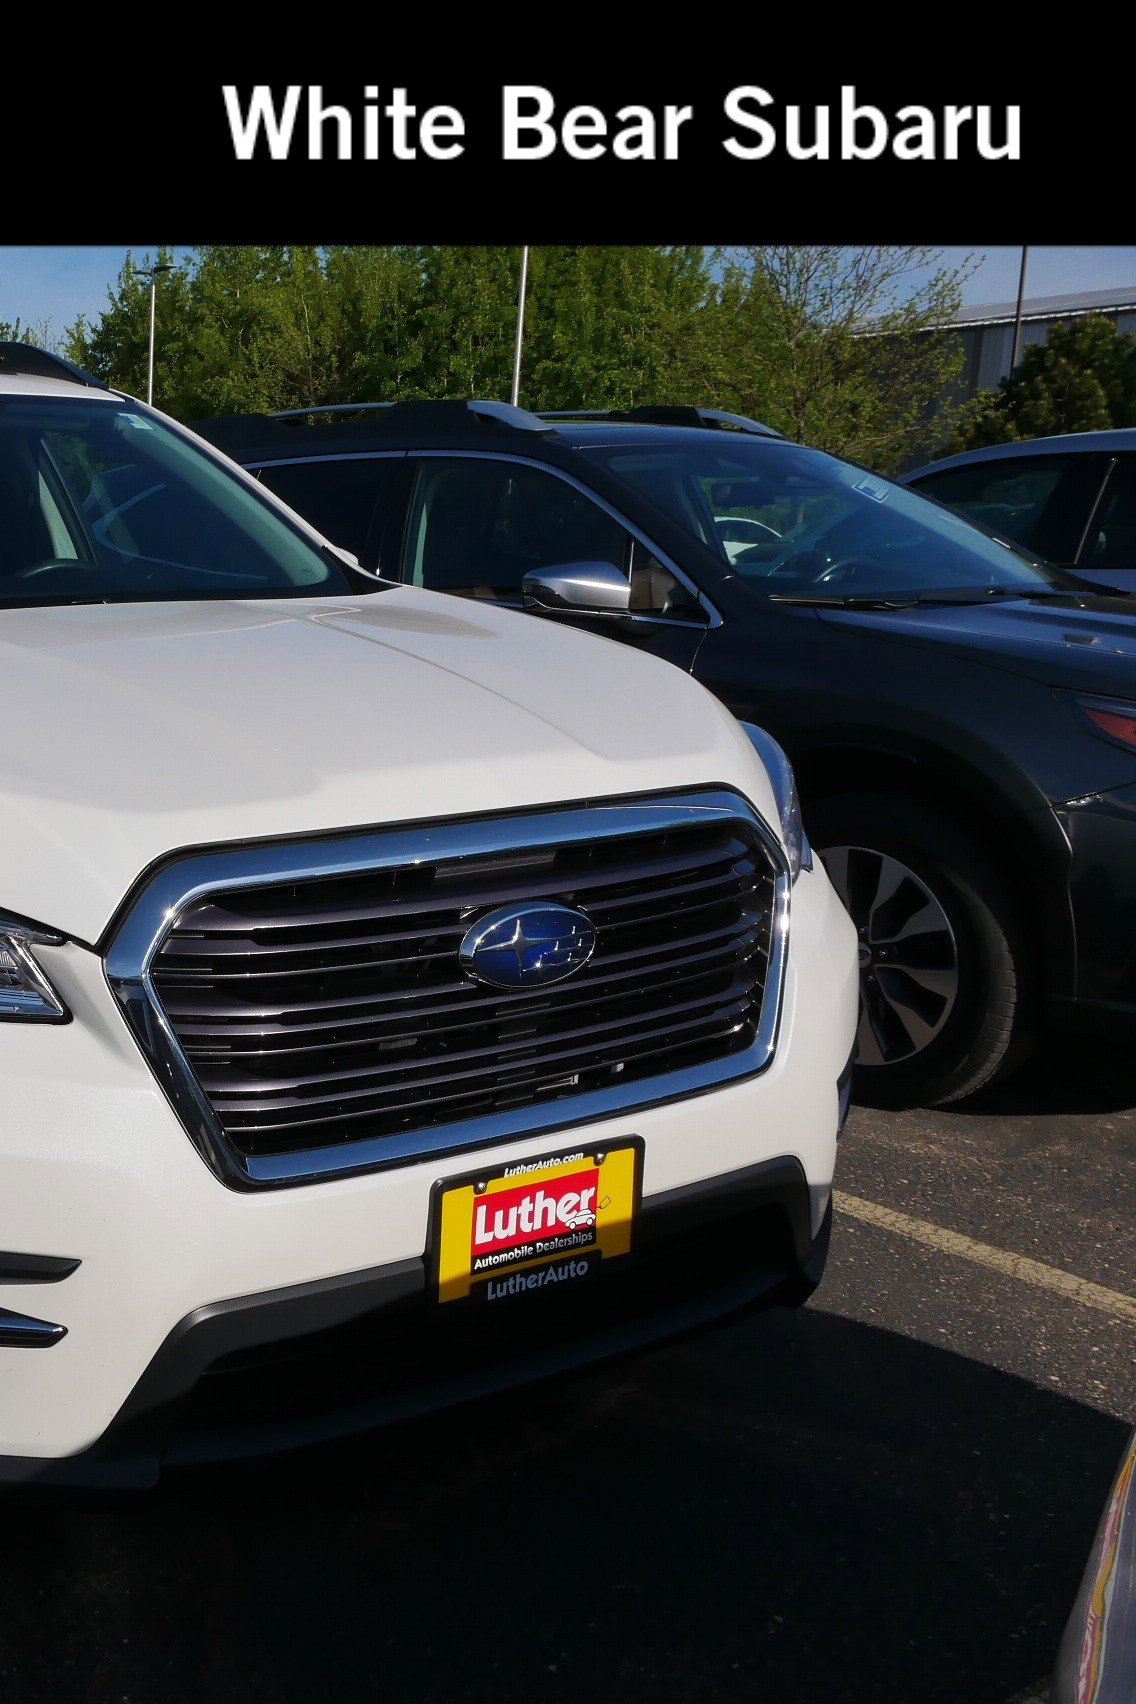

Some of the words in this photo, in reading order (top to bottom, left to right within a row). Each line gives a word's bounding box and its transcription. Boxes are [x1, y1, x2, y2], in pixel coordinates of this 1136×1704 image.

[503, 1152, 583, 1178] LutherAuto.com
[475, 1186, 596, 1245] Luther
[473, 1244, 534, 1270] Automobile
[535, 1230, 594, 1256] Dealerships
[486, 1259, 589, 1301] LutherAuto
